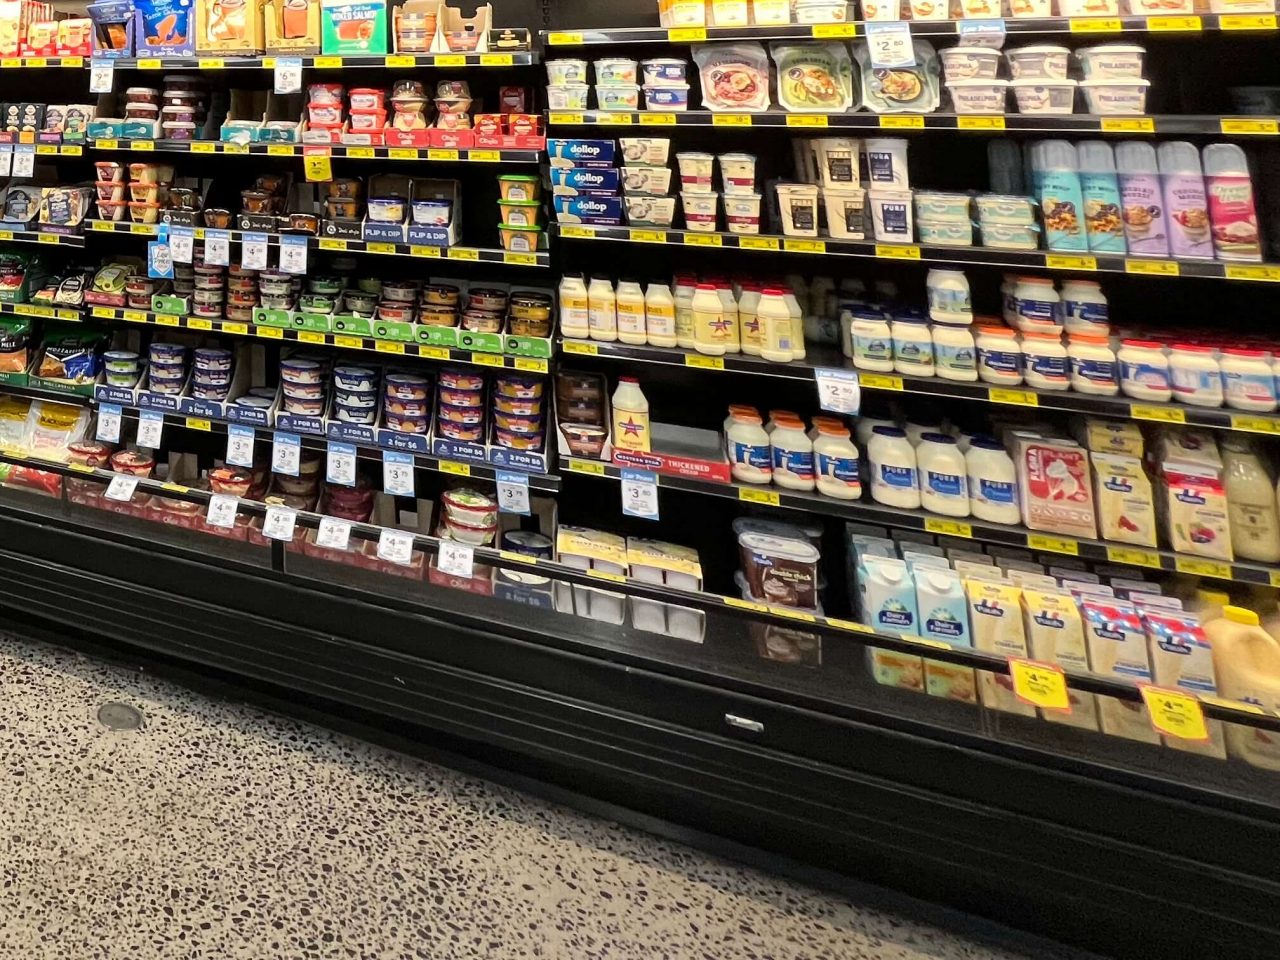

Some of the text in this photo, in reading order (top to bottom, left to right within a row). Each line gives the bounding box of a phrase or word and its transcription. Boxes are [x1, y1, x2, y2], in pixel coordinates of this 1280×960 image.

[570, 144, 600, 155] dollop
[574, 172, 604, 184] dollop
[577, 201, 607, 212] dollop
[883, 204, 905, 212] PURA
[387, 229, 401, 237] DIP
[348, 428, 362, 436] FOR
[393, 439, 406, 448] for
[407, 441, 417, 450] $6
[458, 446, 474, 454] FOR
[475, 448, 483, 456] $6
[515, 455, 531, 464] FOR
[531, 457, 541, 465] $6
[1029, 448, 1039, 481] FLORA
[668, 460, 710, 472] THICKENED
[933, 473, 955, 482] PURA
[985, 481, 1008, 489] PURA
[770, 568, 812, 581] double thick
[882, 616, 910, 625] Farmers
[886, 611, 905, 620] Dairy
[934, 619, 955, 630] Dairy
[929, 625, 960, 636] Farmers
